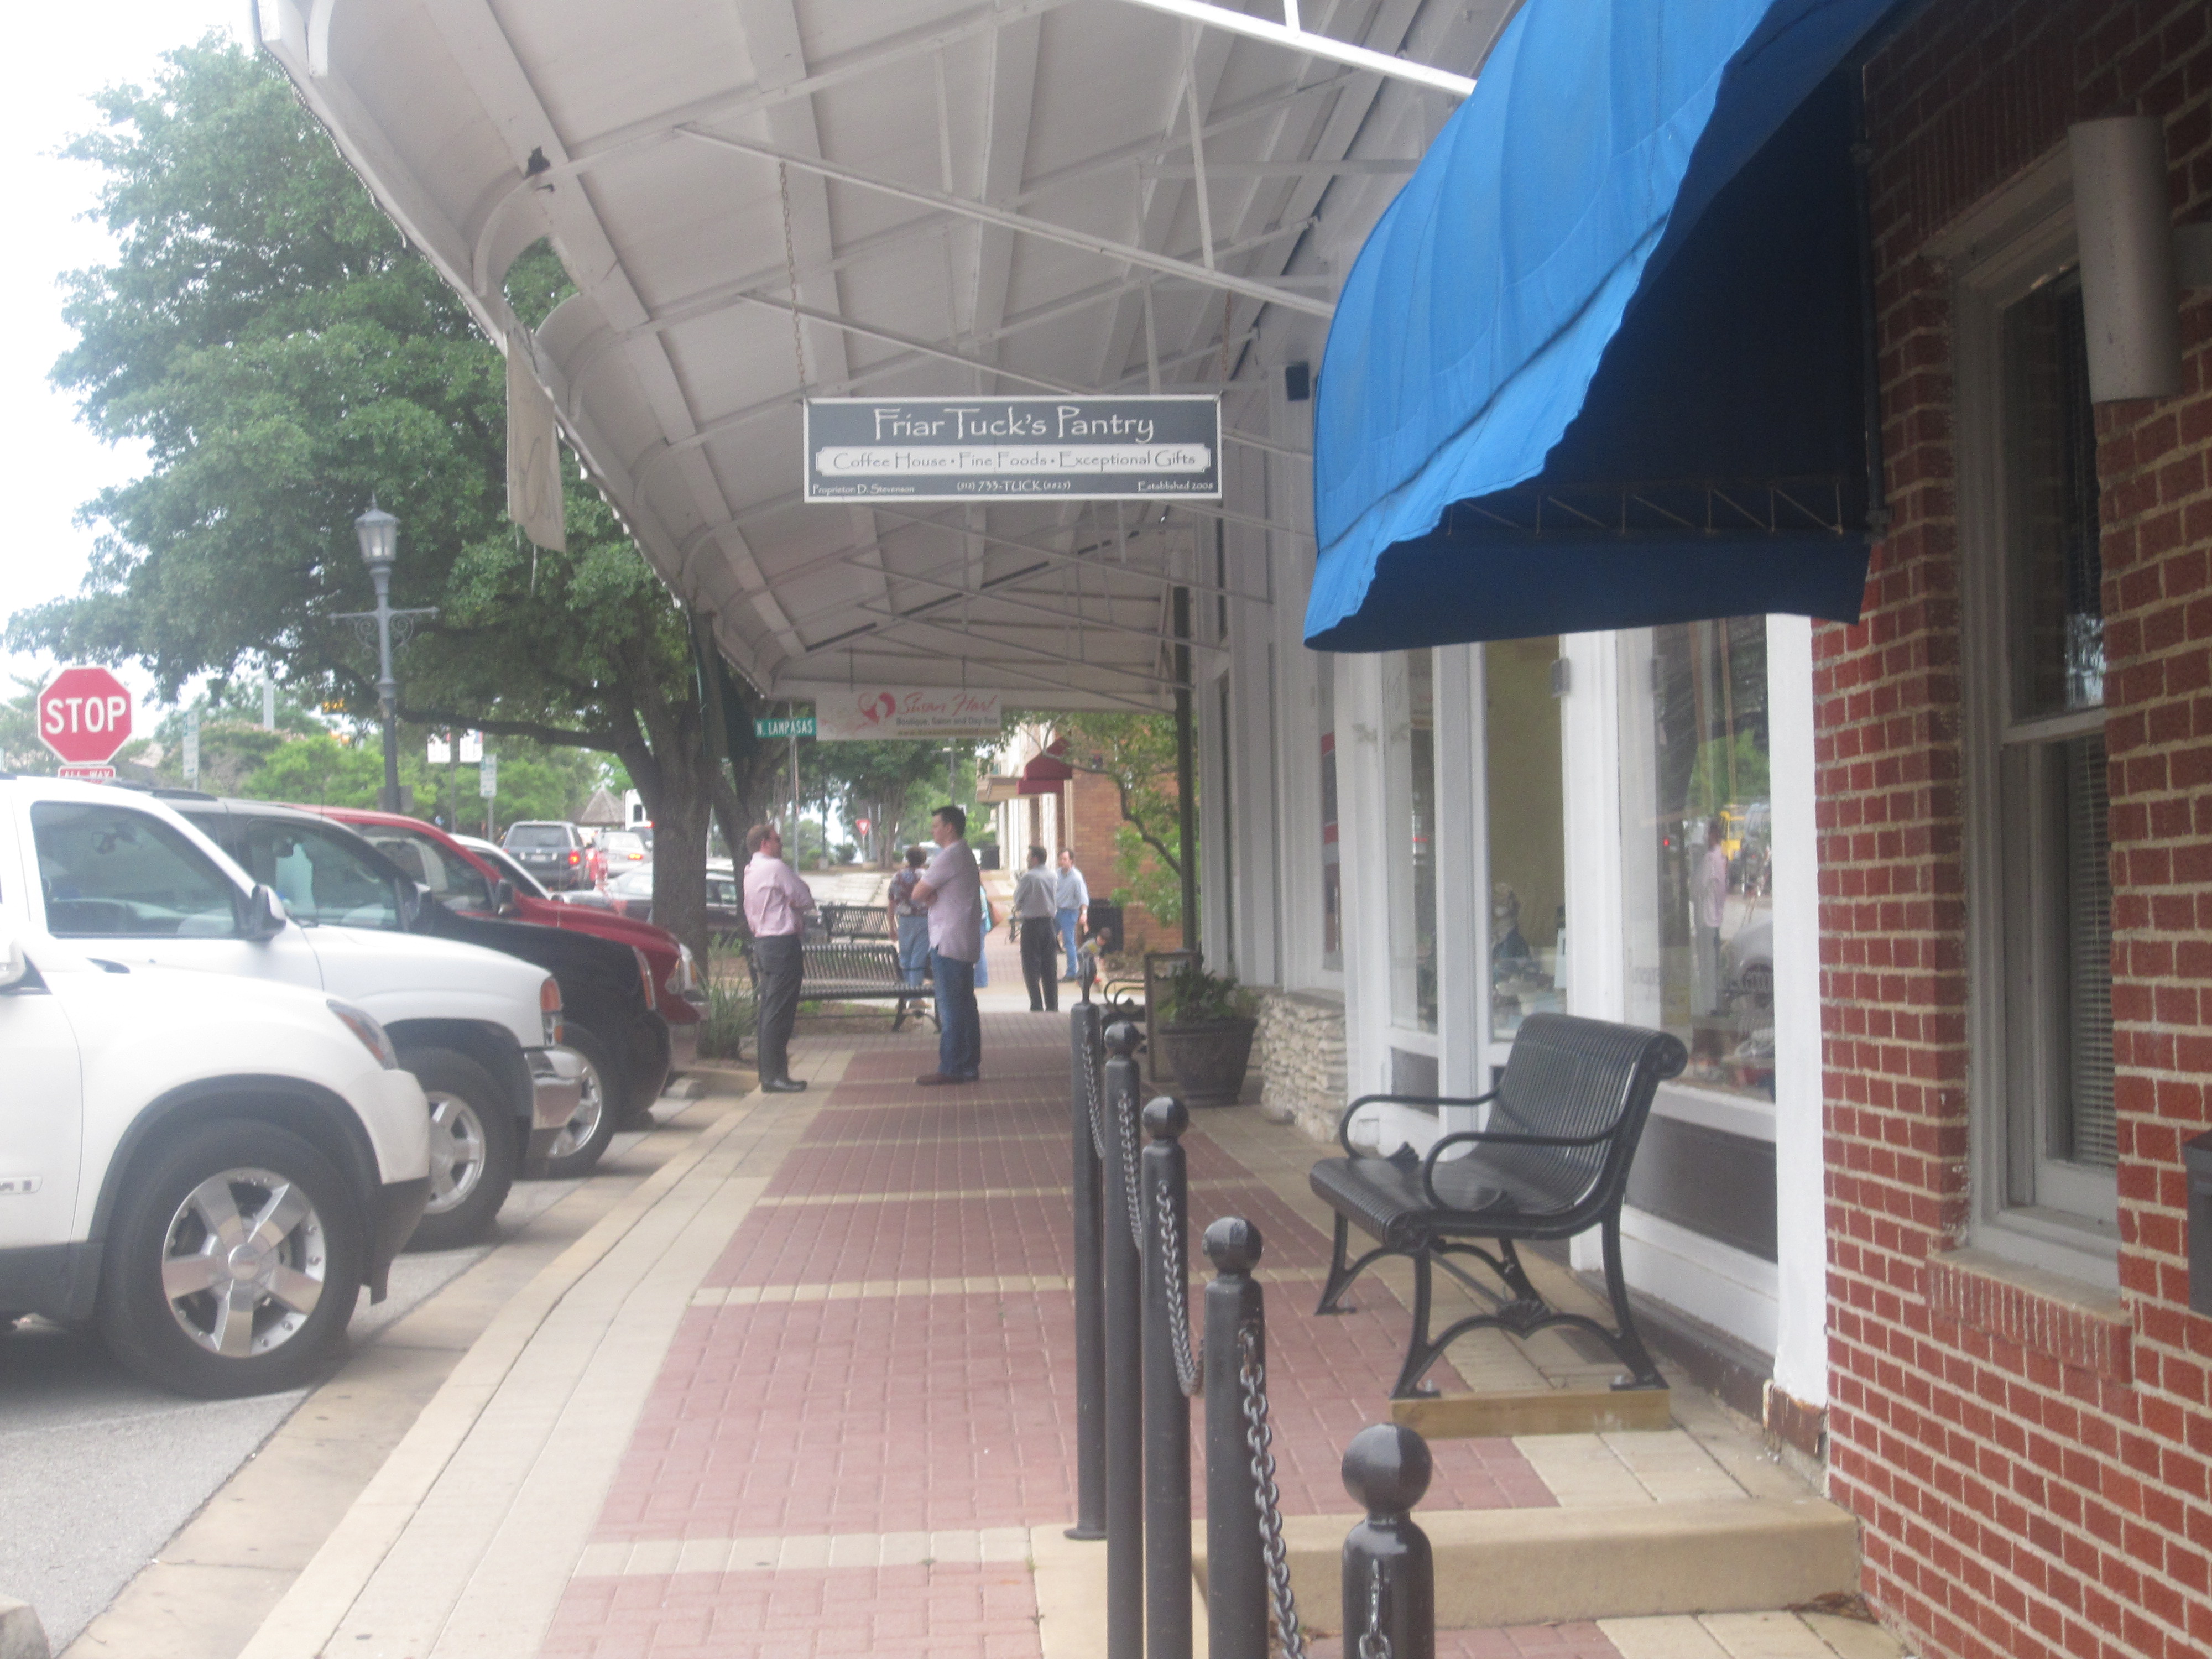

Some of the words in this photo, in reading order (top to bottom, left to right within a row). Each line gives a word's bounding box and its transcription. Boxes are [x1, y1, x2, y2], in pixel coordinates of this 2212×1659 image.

[874, 408, 945, 440] Friar
[943, 406, 1047, 440] Tuck's
[1057, 406, 1154, 444] Pantry
[833, 452, 890, 469] Coffee
[895, 452, 946, 469] House
[959, 451, 992, 468] Fine
[998, 451, 1046, 468] Foods
[1059, 450, 1150, 472] Exceptional
[1155, 450, 1195, 467] Gifts
[977, 479, 1042, 492] 733-TUCK
[1138, 480, 1190, 492] Established
[45, 696, 126, 734] STOP
[768, 718, 813, 735] LAMPASAS
